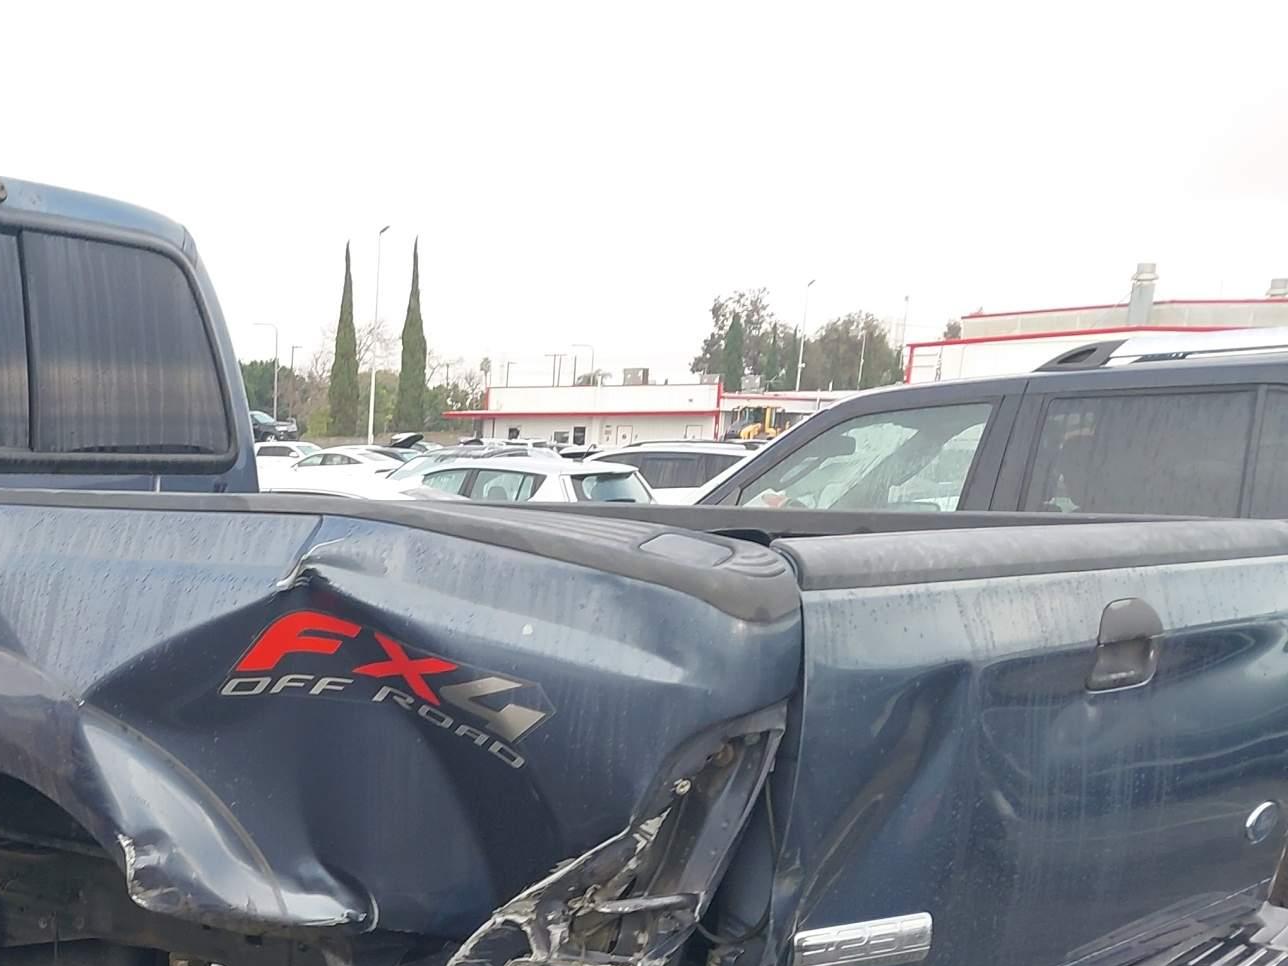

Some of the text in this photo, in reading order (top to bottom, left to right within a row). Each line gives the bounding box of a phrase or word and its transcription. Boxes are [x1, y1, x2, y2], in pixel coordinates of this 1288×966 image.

[220, 674, 527, 768] OFF ROAD
[234, 610, 547, 742] FX4
